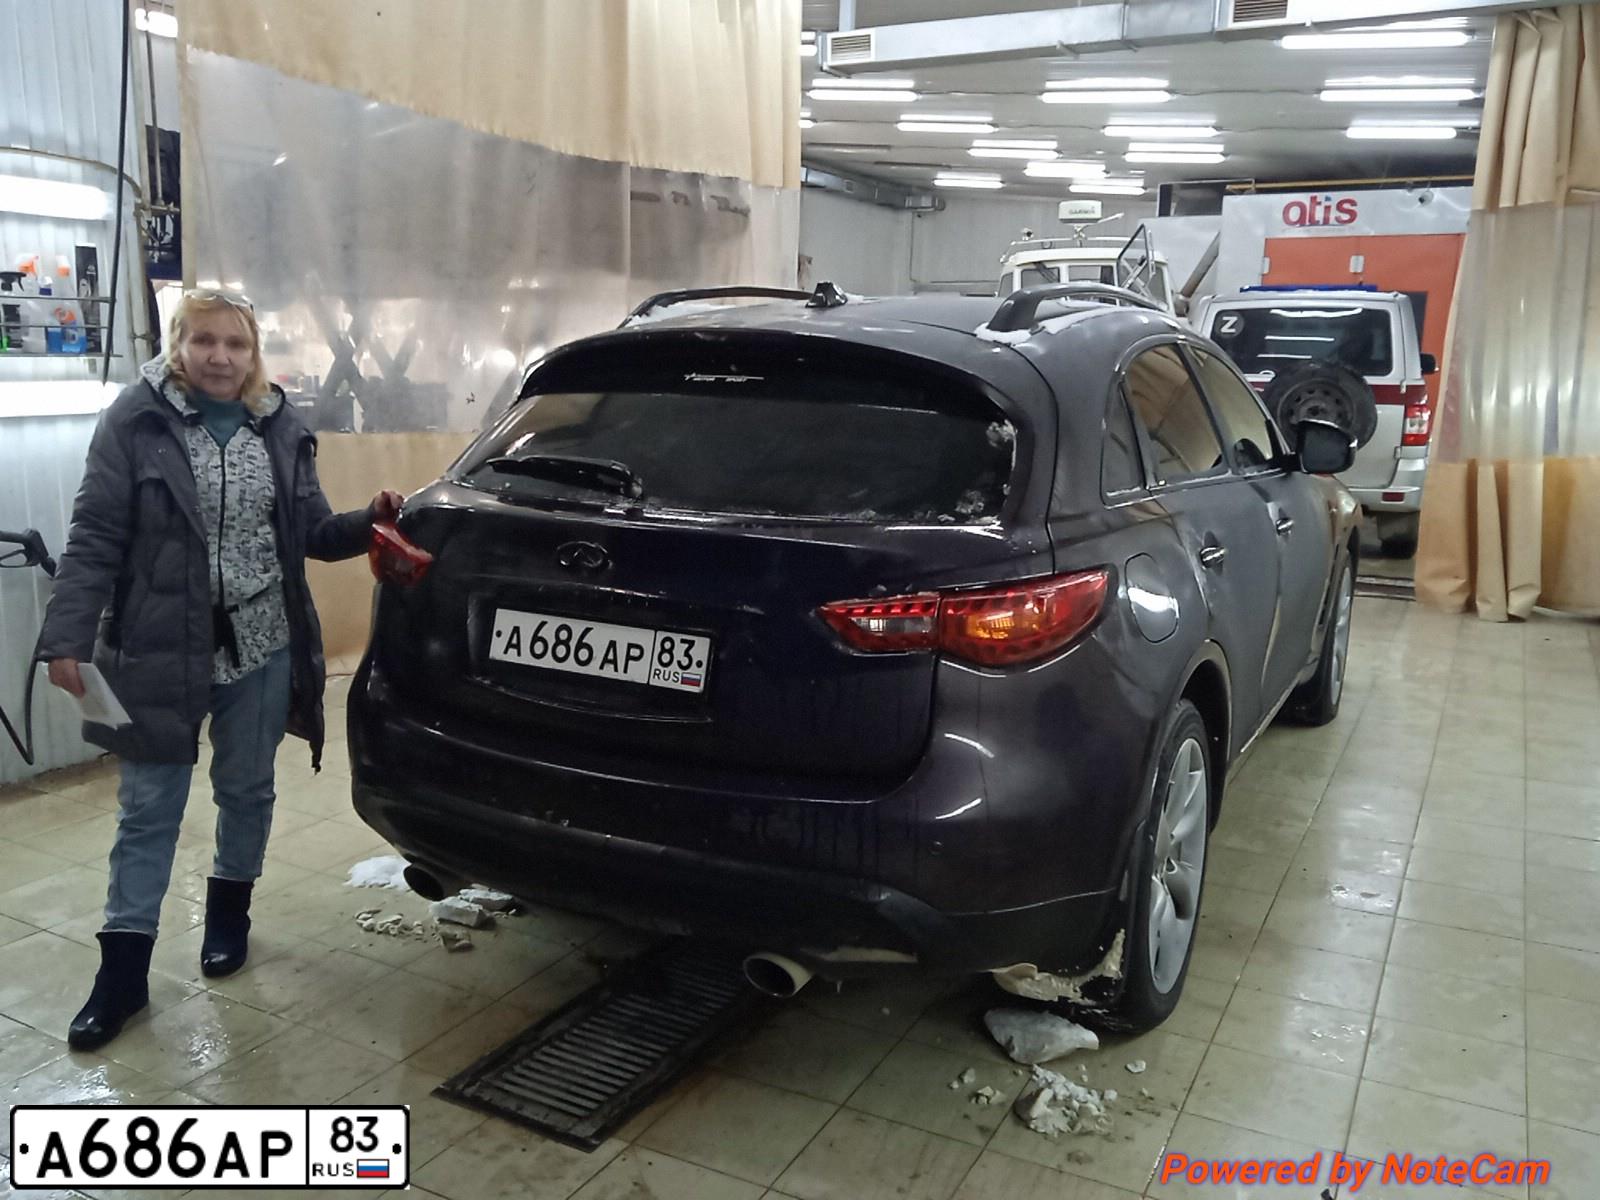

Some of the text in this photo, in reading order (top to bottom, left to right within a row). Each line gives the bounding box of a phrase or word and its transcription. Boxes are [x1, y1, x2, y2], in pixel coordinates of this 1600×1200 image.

[1220, 316, 1238, 333] Z
[657, 636, 696, 671] 83
[653, 668, 680, 684] RUS
